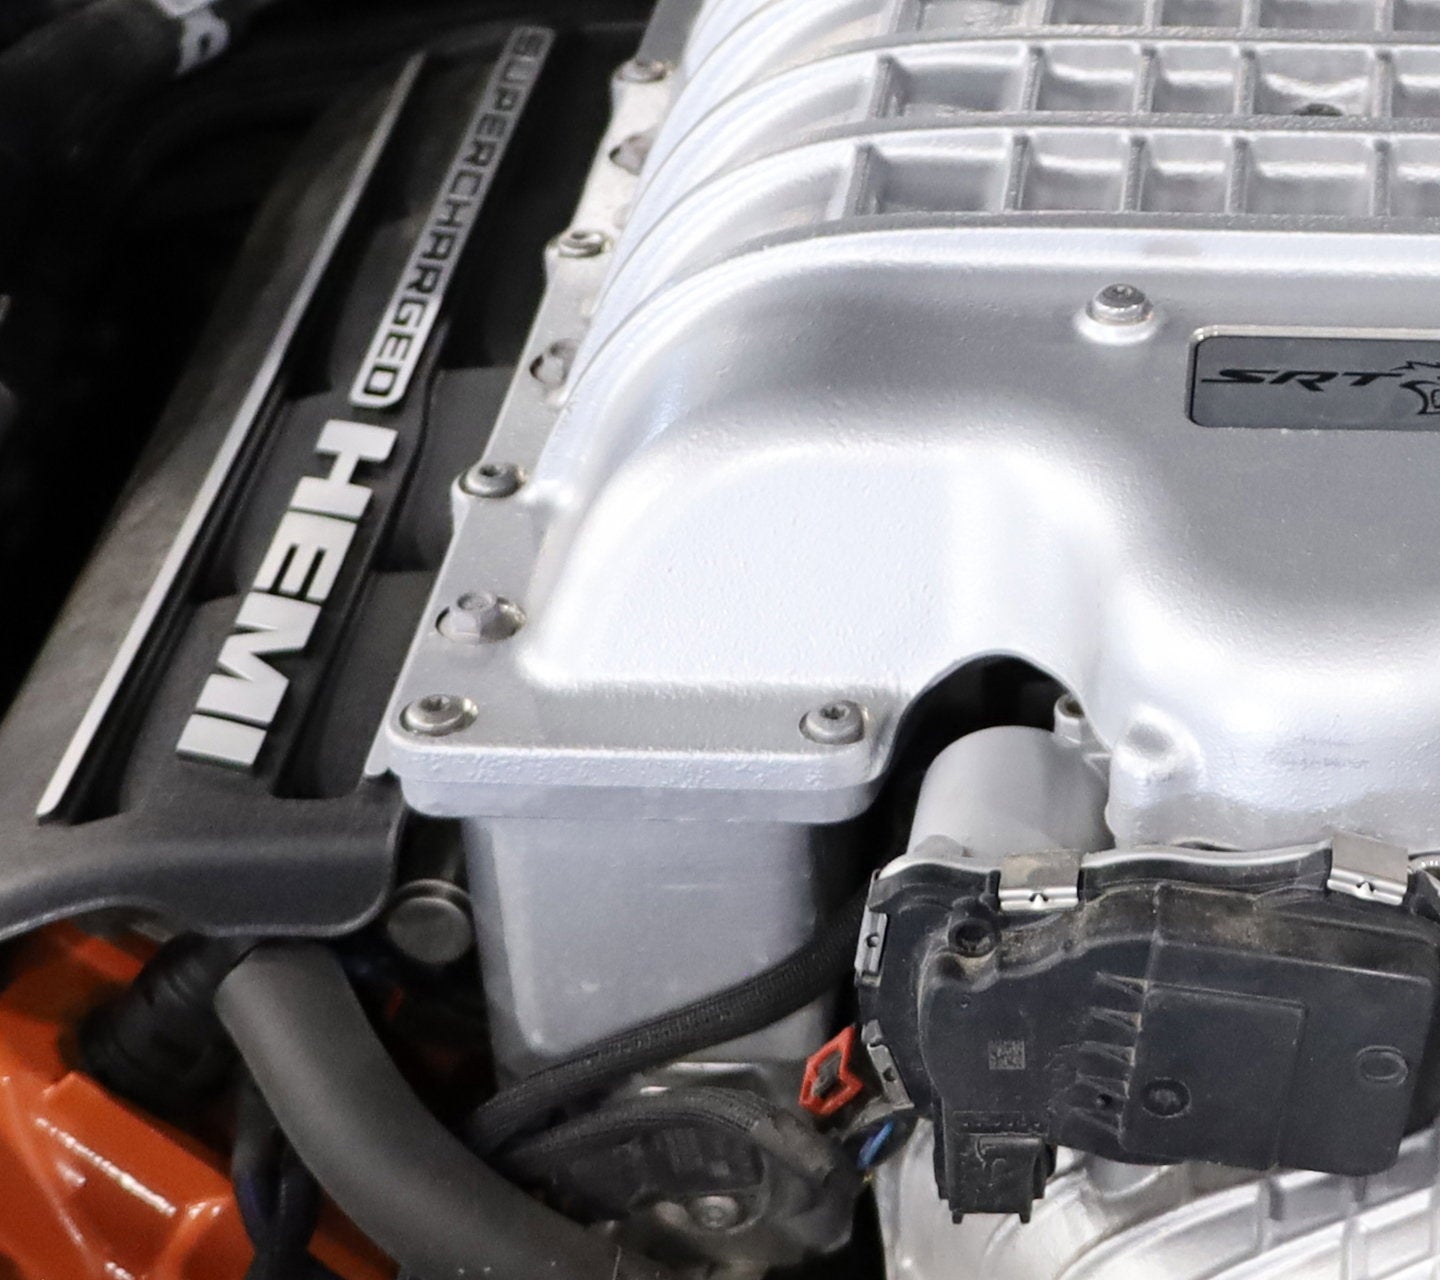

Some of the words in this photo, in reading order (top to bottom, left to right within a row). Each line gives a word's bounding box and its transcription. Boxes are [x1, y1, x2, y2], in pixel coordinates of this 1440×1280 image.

[362, 31, 550, 399] SUPERCHARGED
[1201, 368, 1405, 392] SRT
[177, 419, 398, 767] HEMI
